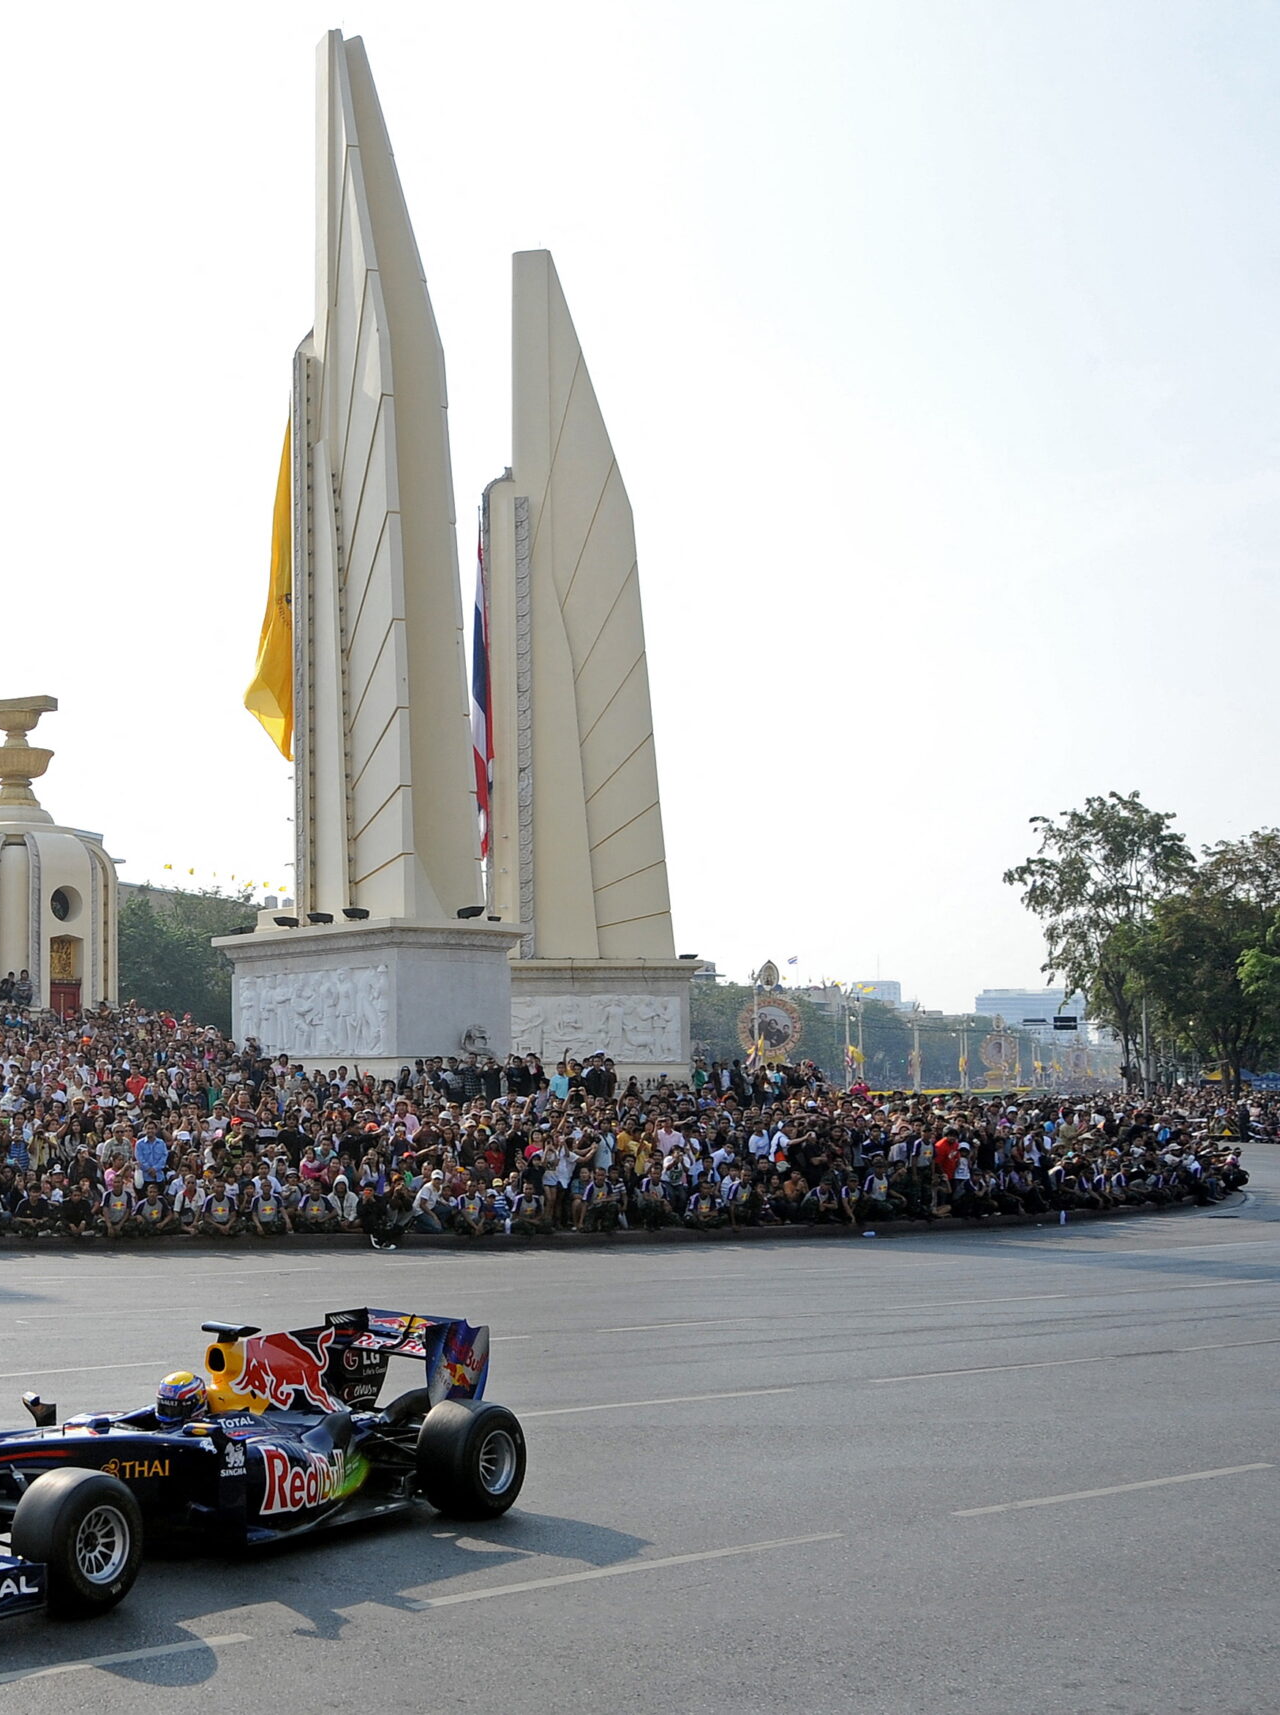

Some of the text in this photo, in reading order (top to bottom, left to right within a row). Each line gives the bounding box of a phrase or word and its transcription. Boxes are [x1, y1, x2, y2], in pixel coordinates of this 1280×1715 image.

[362, 1351, 380, 1365] LG
[217, 1416, 255, 1429] TOTAL
[121, 1459, 170, 1479] THAI
[220, 1467, 247, 1477] SINGHA
[259, 1445, 320, 1515] Red
